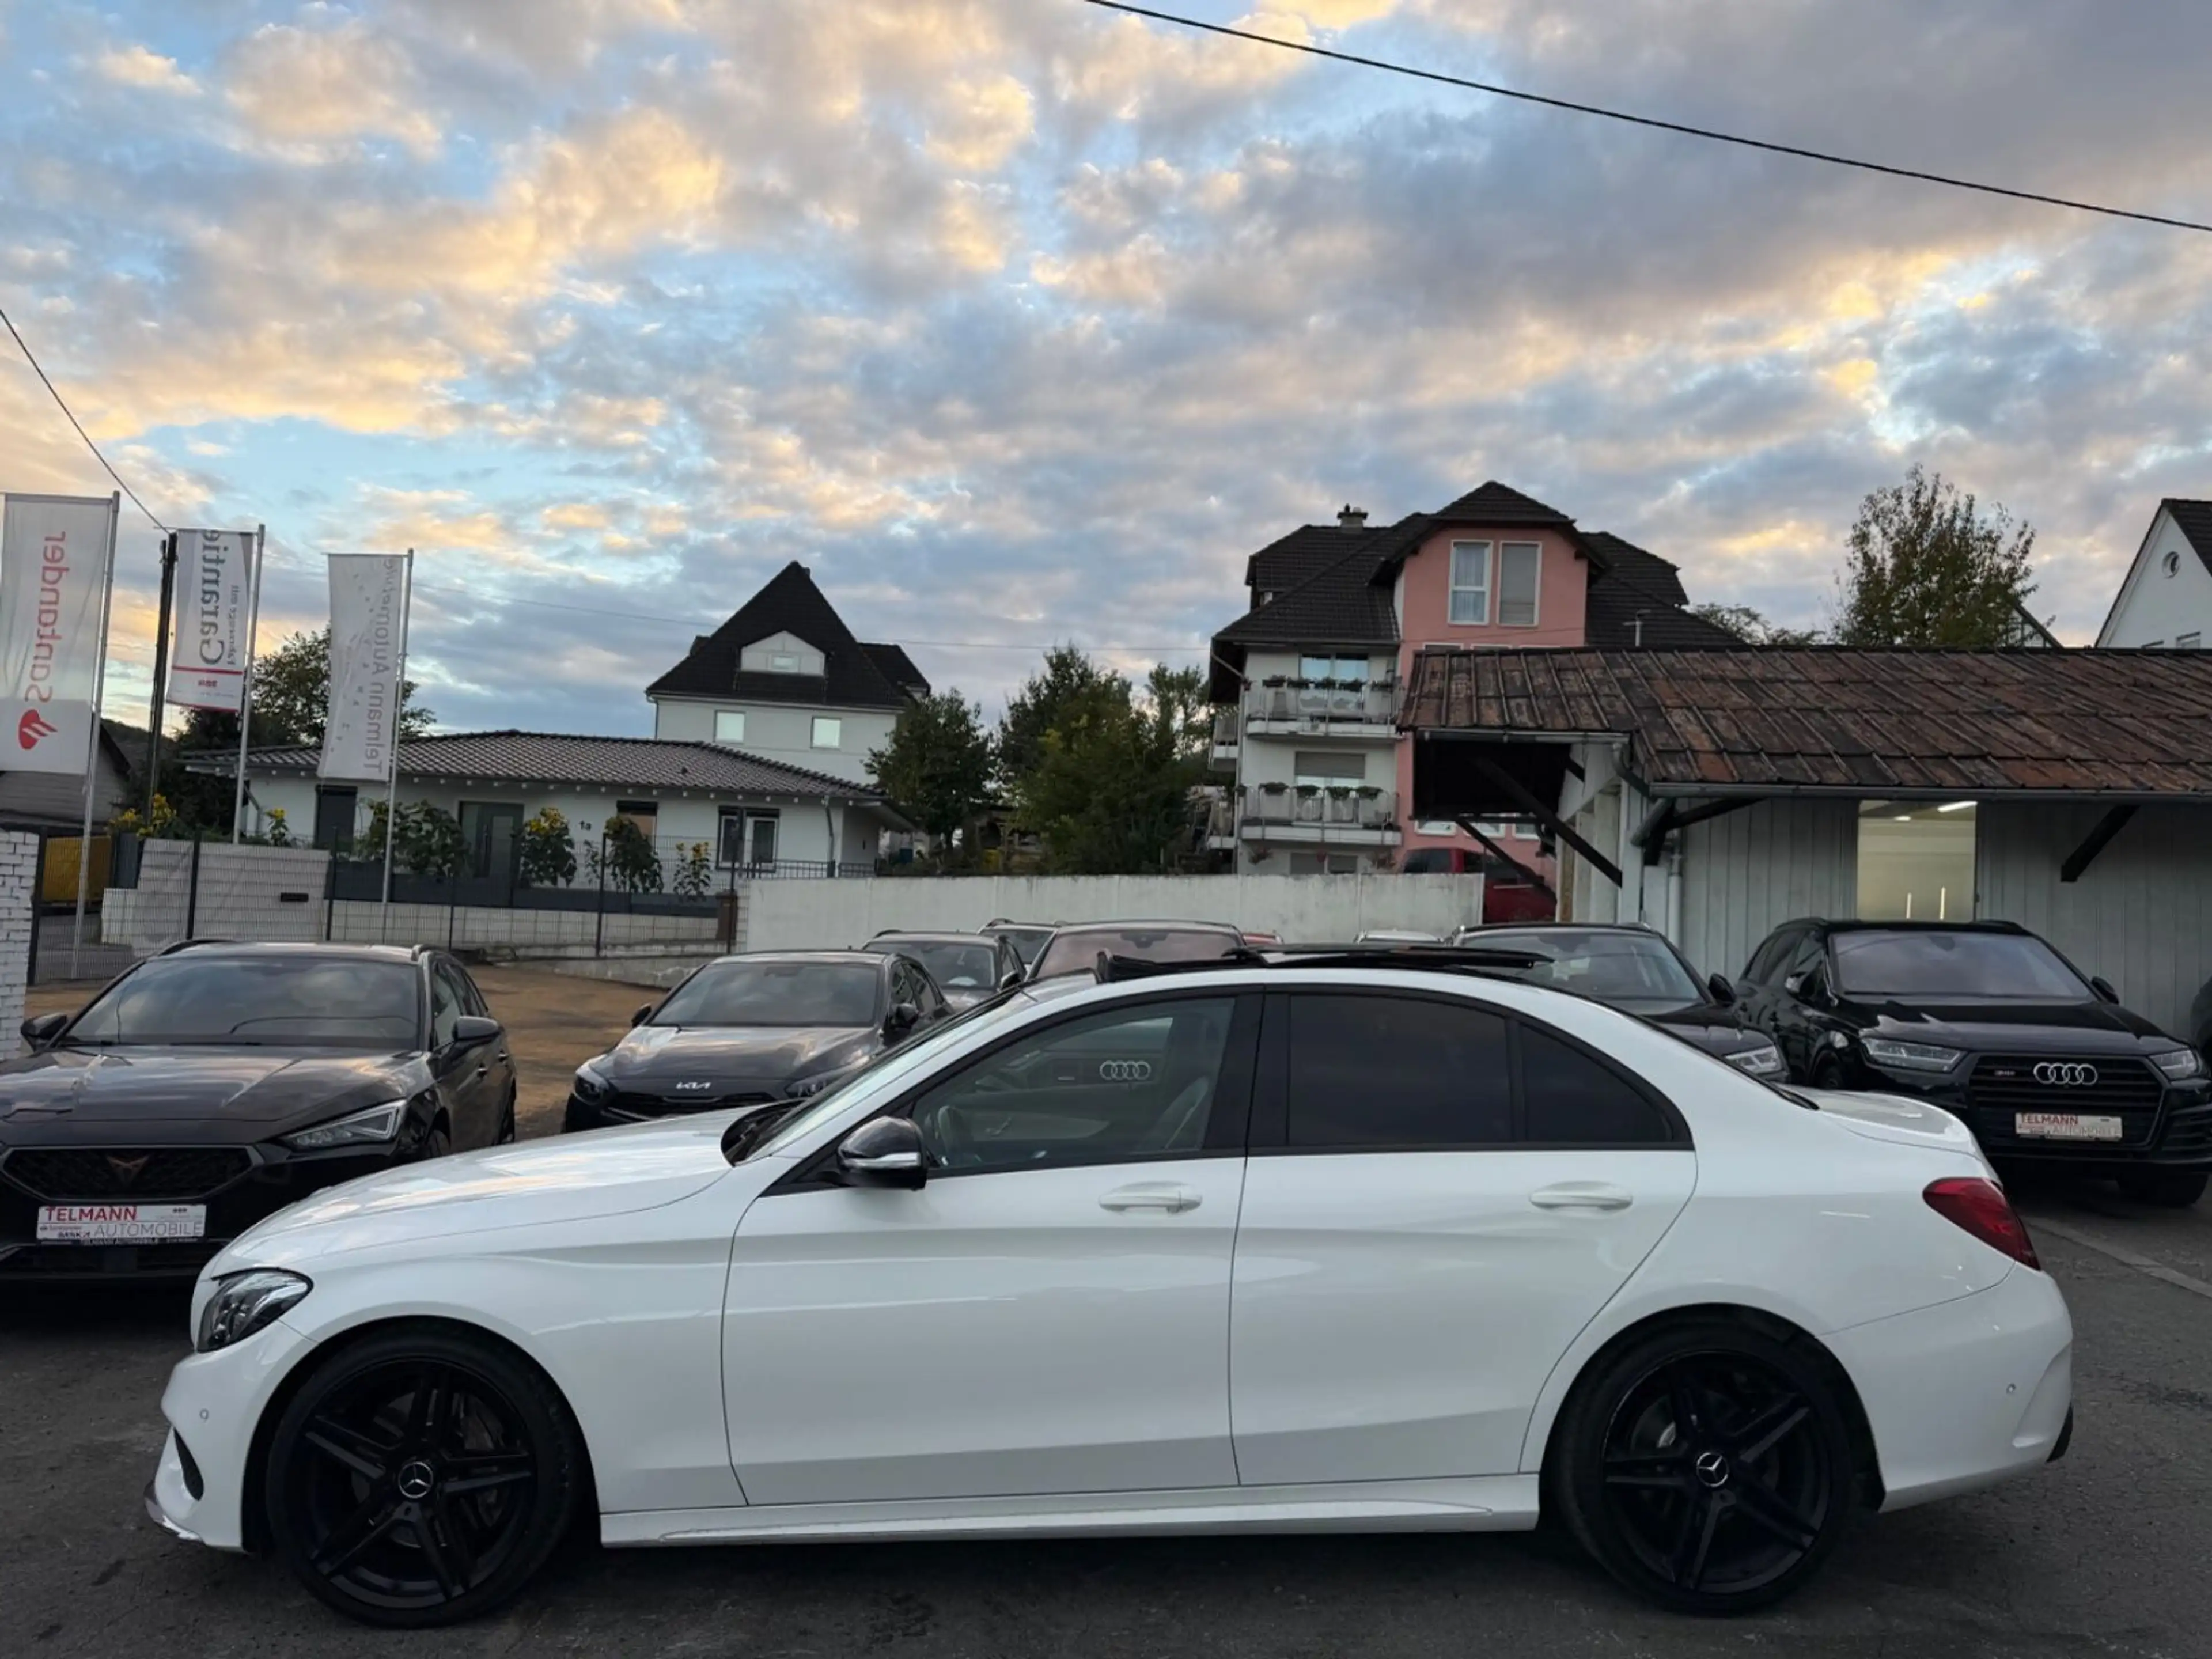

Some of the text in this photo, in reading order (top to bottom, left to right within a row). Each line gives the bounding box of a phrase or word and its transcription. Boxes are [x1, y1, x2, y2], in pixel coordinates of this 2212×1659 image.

[2022, 1115, 2079, 1125] TELMANN
[47, 1206, 137, 1221] TELMANN
[94, 1222, 202, 1237] AUTOMOBILE
